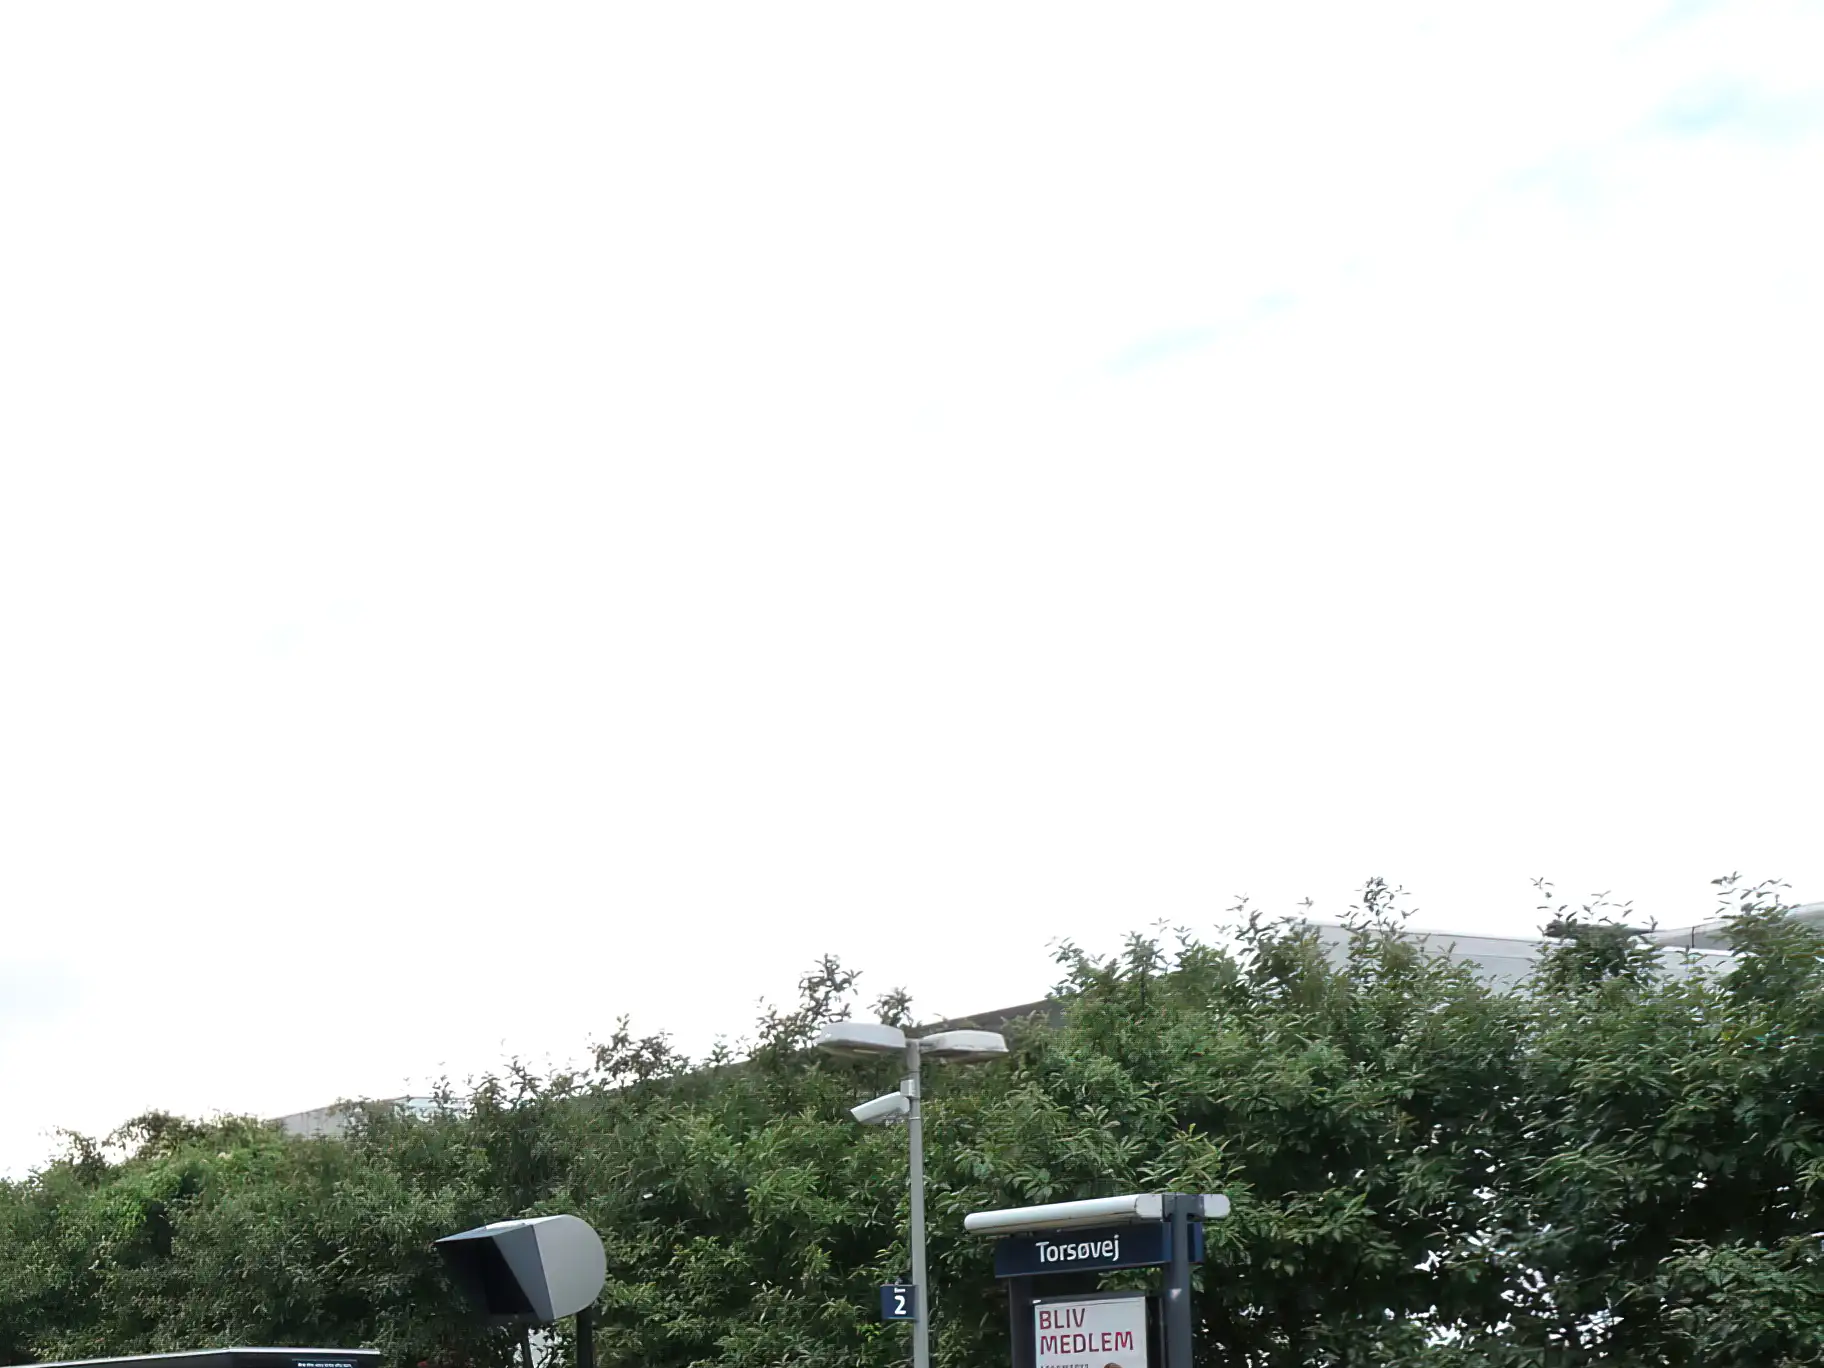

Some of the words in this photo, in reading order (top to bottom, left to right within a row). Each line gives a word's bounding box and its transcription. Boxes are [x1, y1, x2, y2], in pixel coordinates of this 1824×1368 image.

[1035, 1234, 1120, 1263] Torsøvej
[894, 1295, 907, 1315] 2
[1039, 1308, 1086, 1330] BLIV
[1040, 1331, 1135, 1356] MEDLEM
